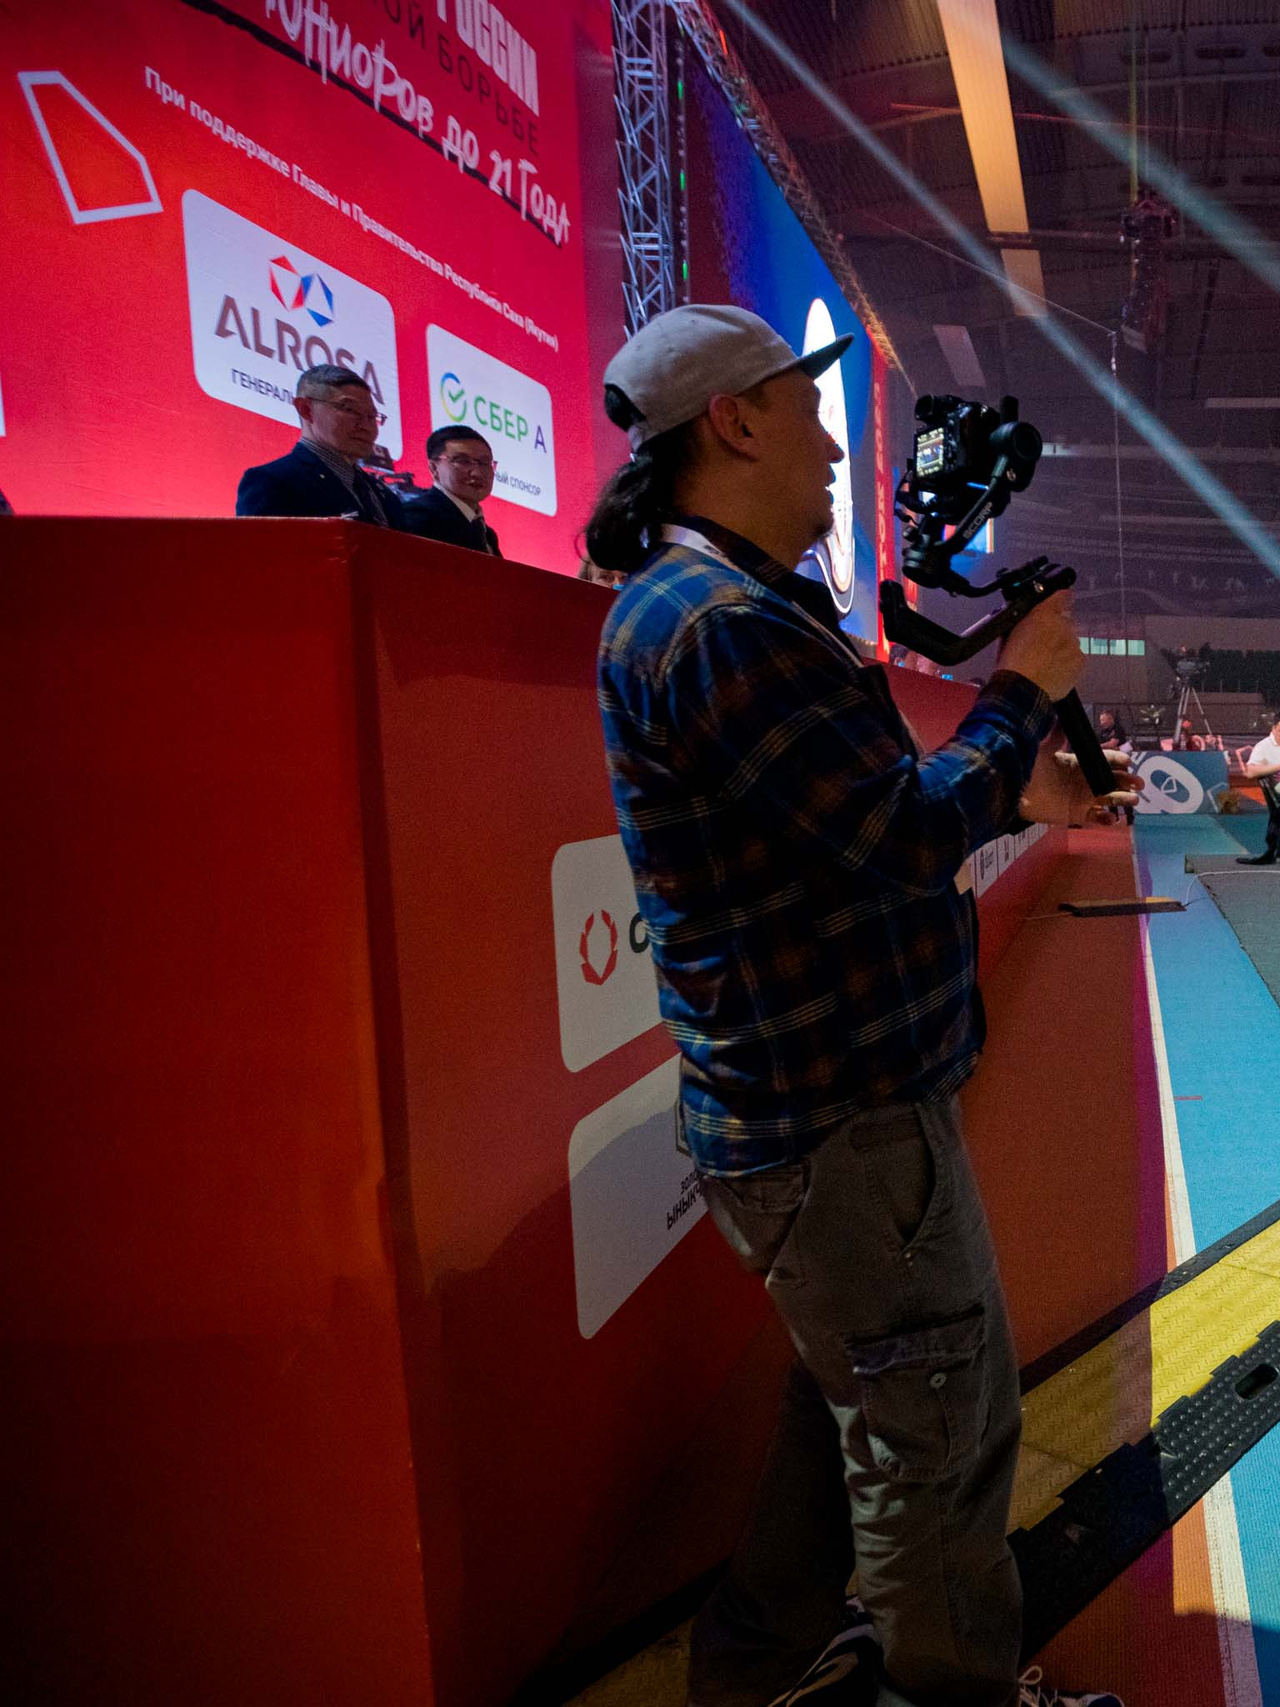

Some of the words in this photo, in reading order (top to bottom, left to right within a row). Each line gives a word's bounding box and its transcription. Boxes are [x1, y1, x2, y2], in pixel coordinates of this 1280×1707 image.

[439, 31, 539, 155] БОРЬБЕ
[145, 66, 186, 110] При
[190, 100, 291, 178] поддержке
[292, 163, 339, 209] Главы
[340, 199, 350, 217] и
[352, 202, 444, 277] Правительства
[444, 262, 503, 314] Республики
[503, 302, 525, 328] Саха
[489, 150, 512, 198] 21
[474, 395, 529, 441] СБЕР
[510, 476, 541, 496] СПОНСОР
